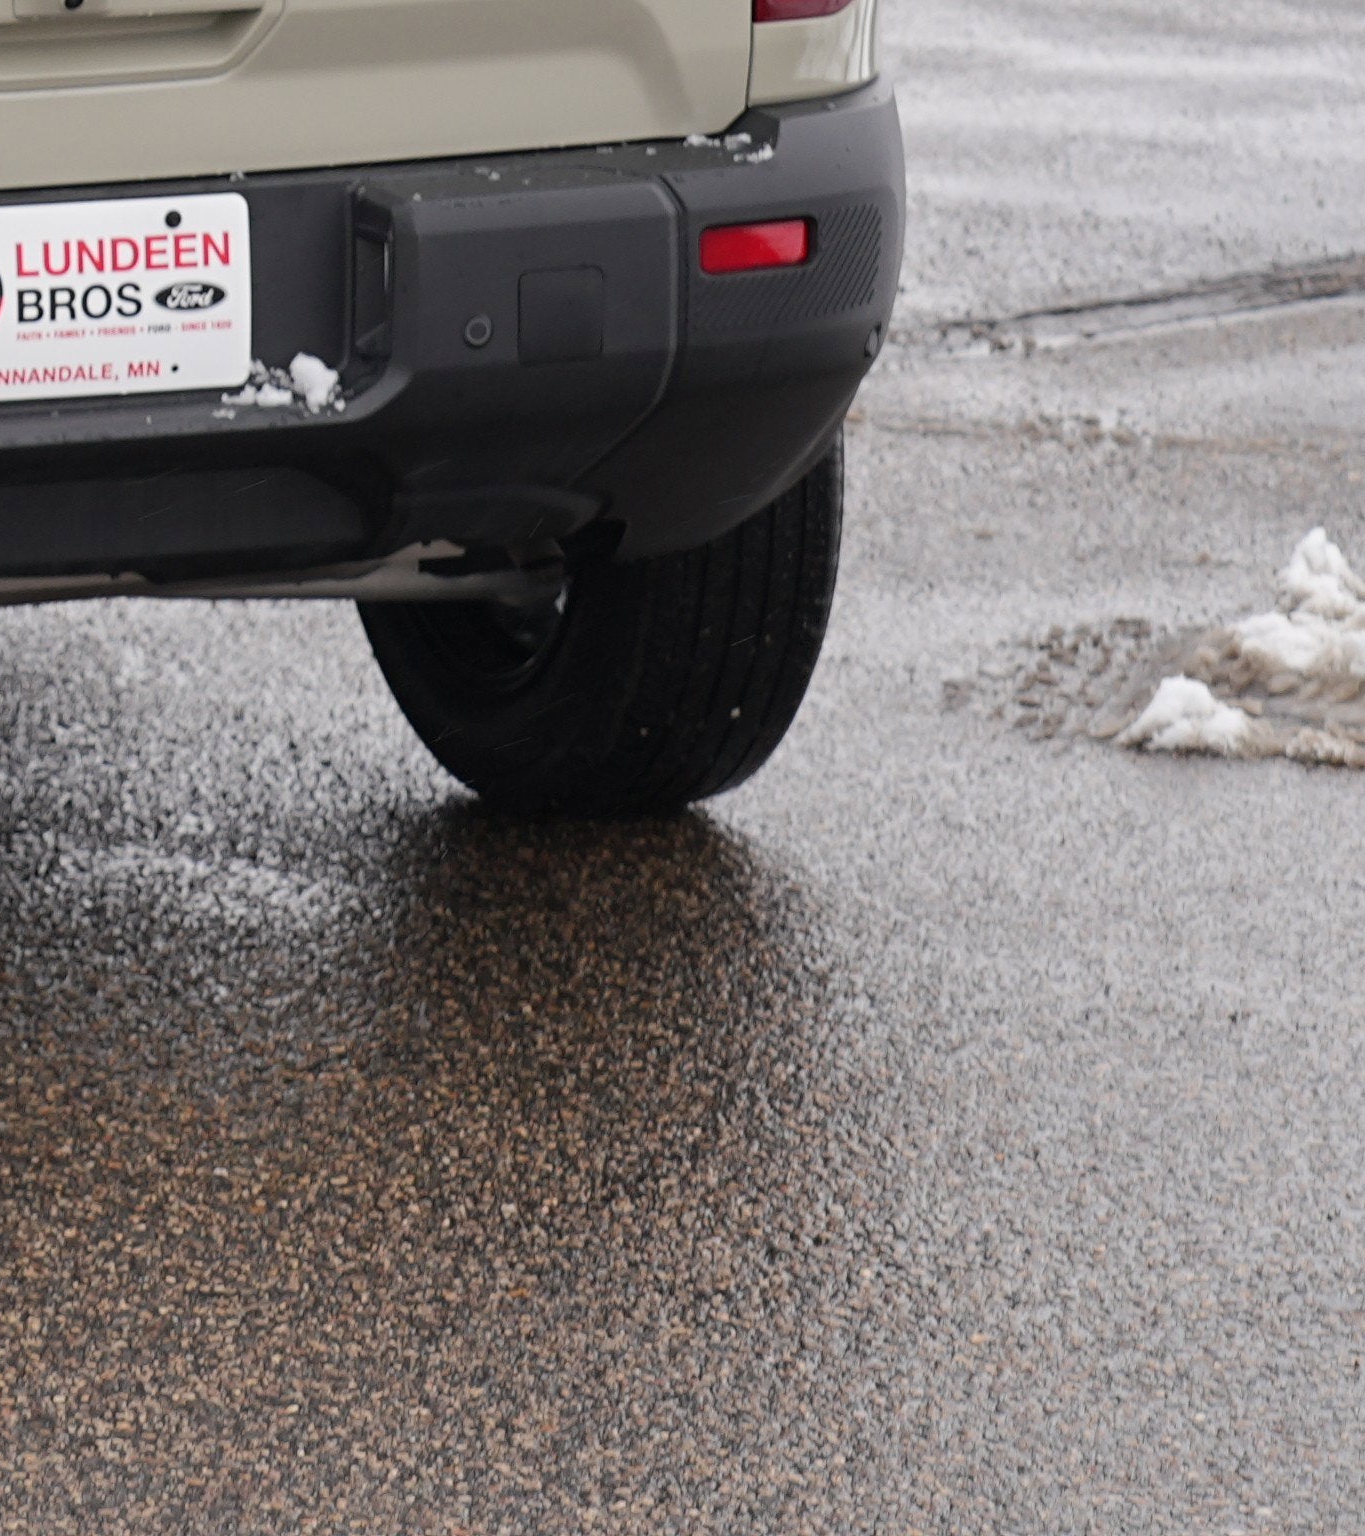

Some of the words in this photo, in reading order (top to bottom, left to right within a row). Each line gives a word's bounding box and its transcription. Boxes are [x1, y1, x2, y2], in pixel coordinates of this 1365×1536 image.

[15, 231, 231, 278] LUNDEEN
[17, 282, 142, 323] BROS
[127, 361, 160, 378] MN
